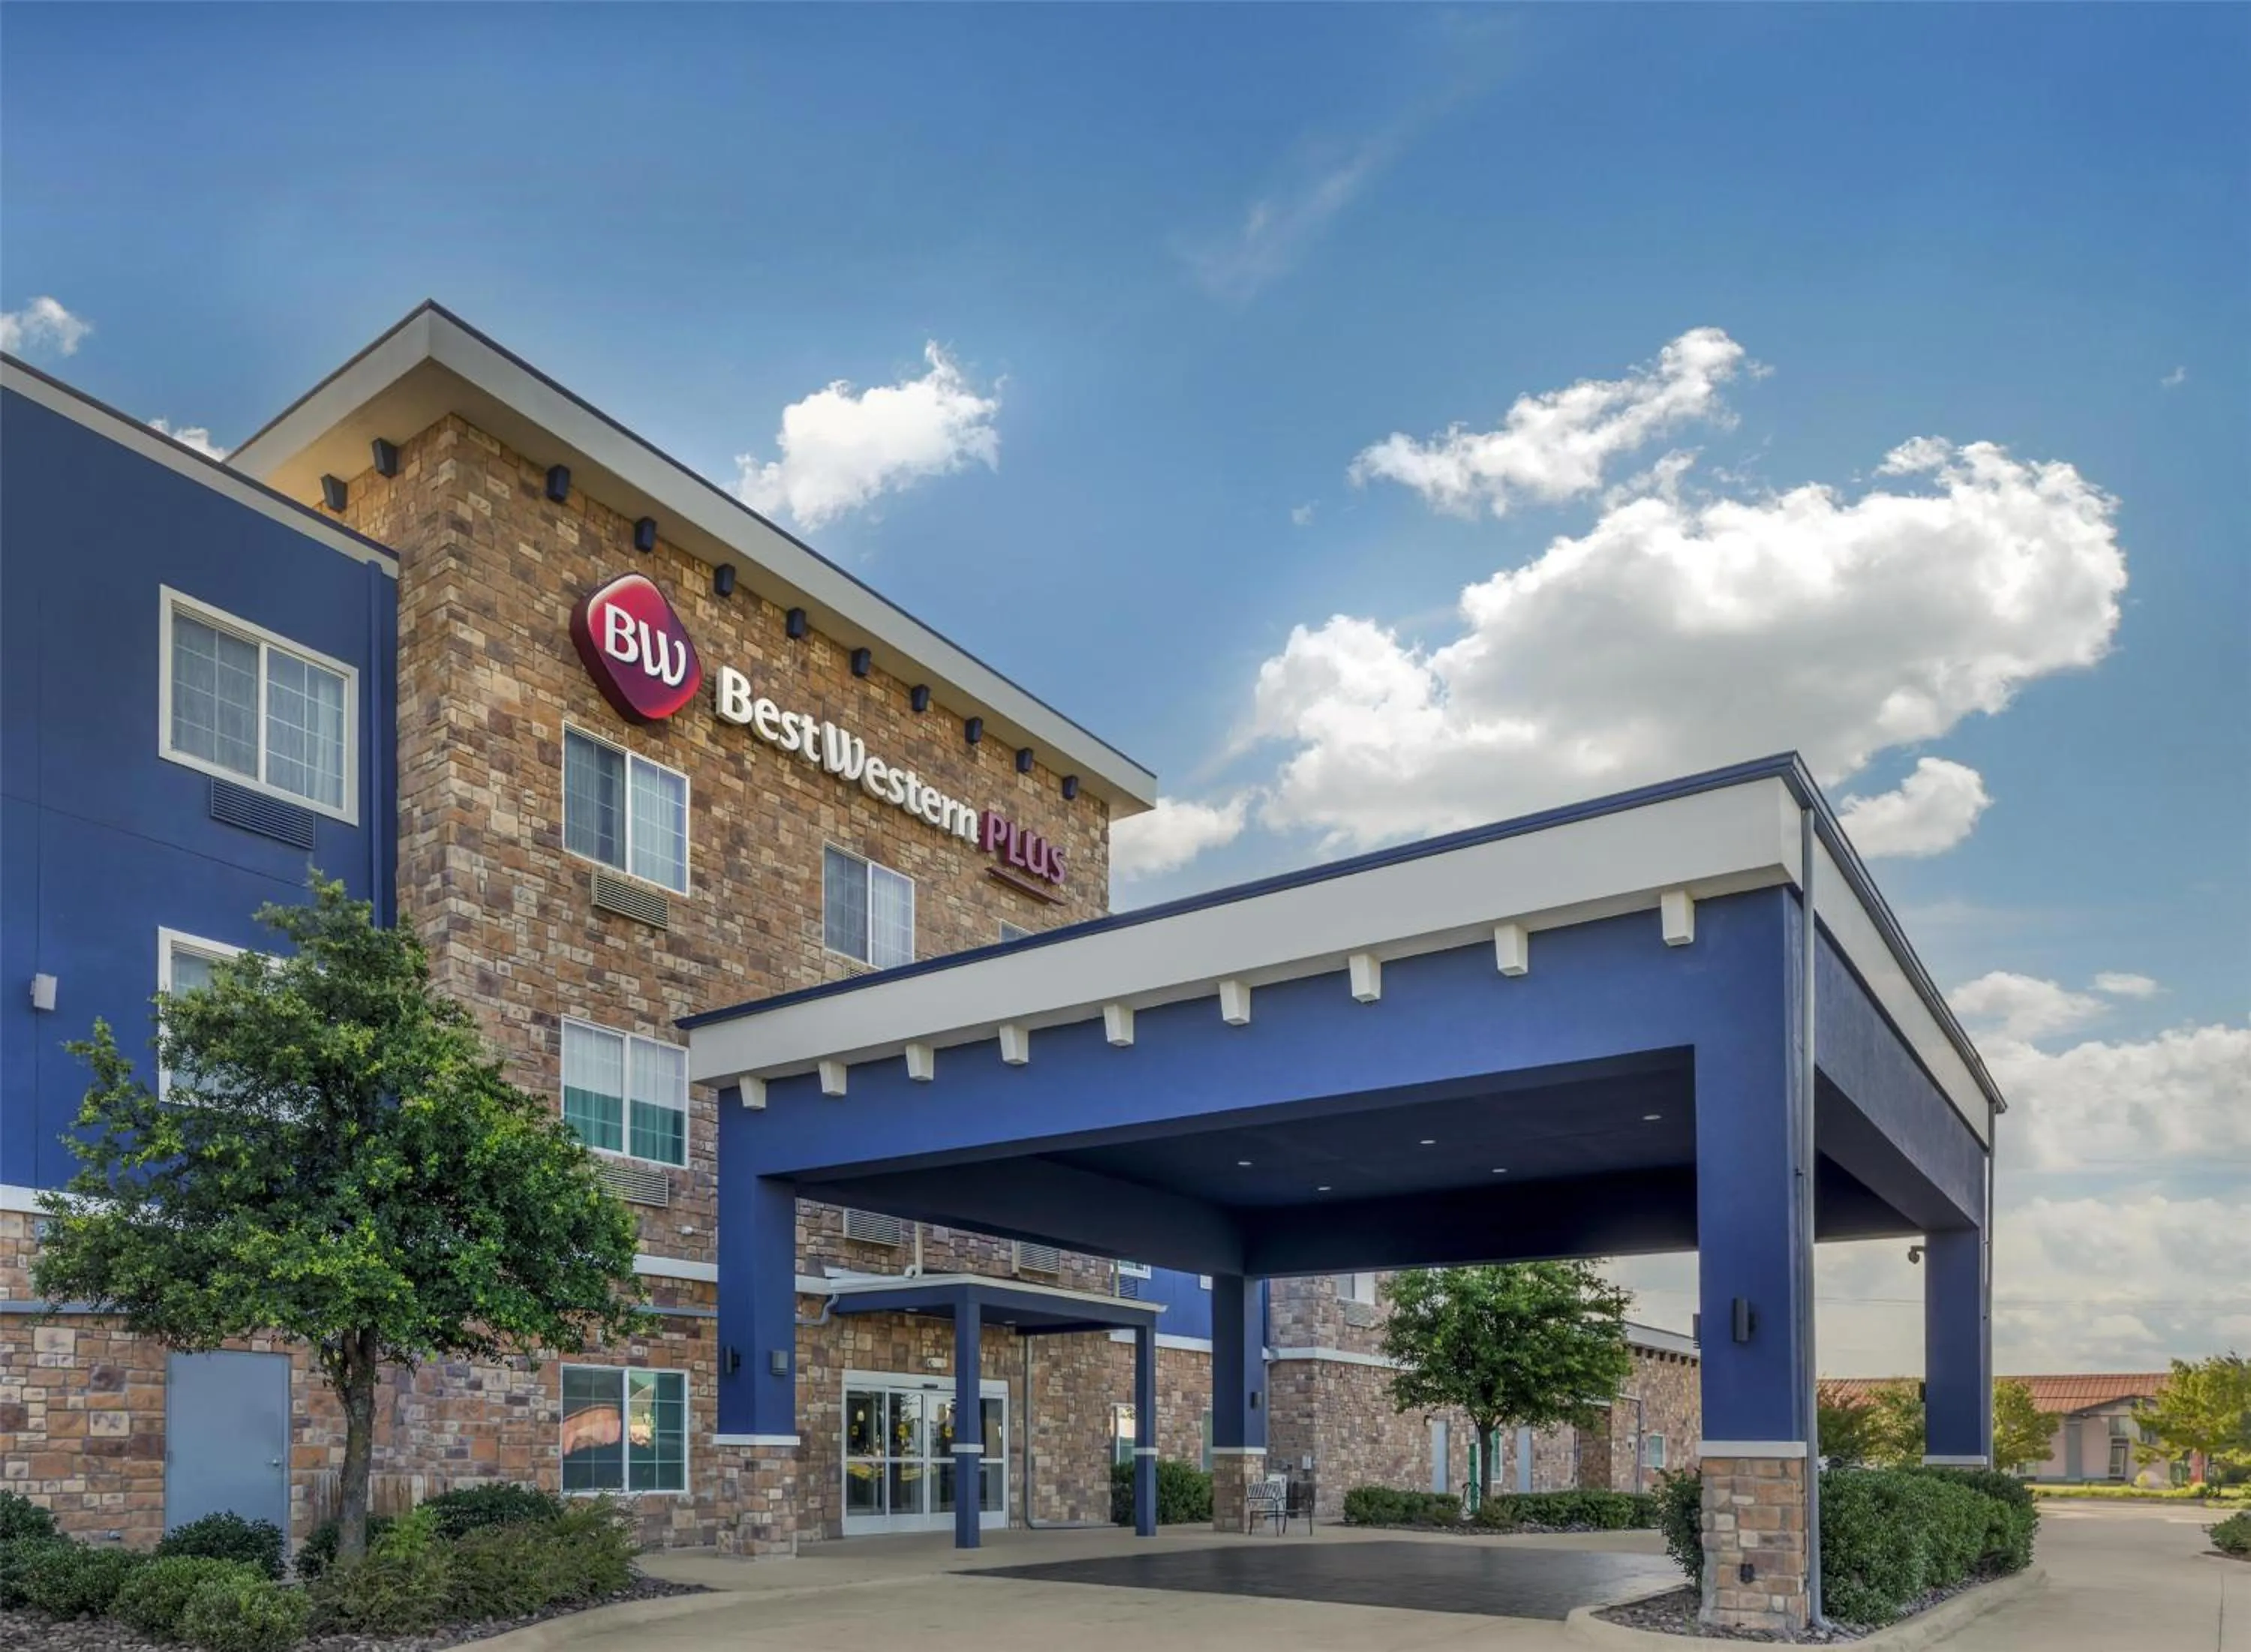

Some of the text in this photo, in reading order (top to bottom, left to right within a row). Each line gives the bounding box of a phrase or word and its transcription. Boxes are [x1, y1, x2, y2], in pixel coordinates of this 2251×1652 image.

[605, 602, 686, 686] BW
[717, 665, 1065, 886] Best Western PLUS
